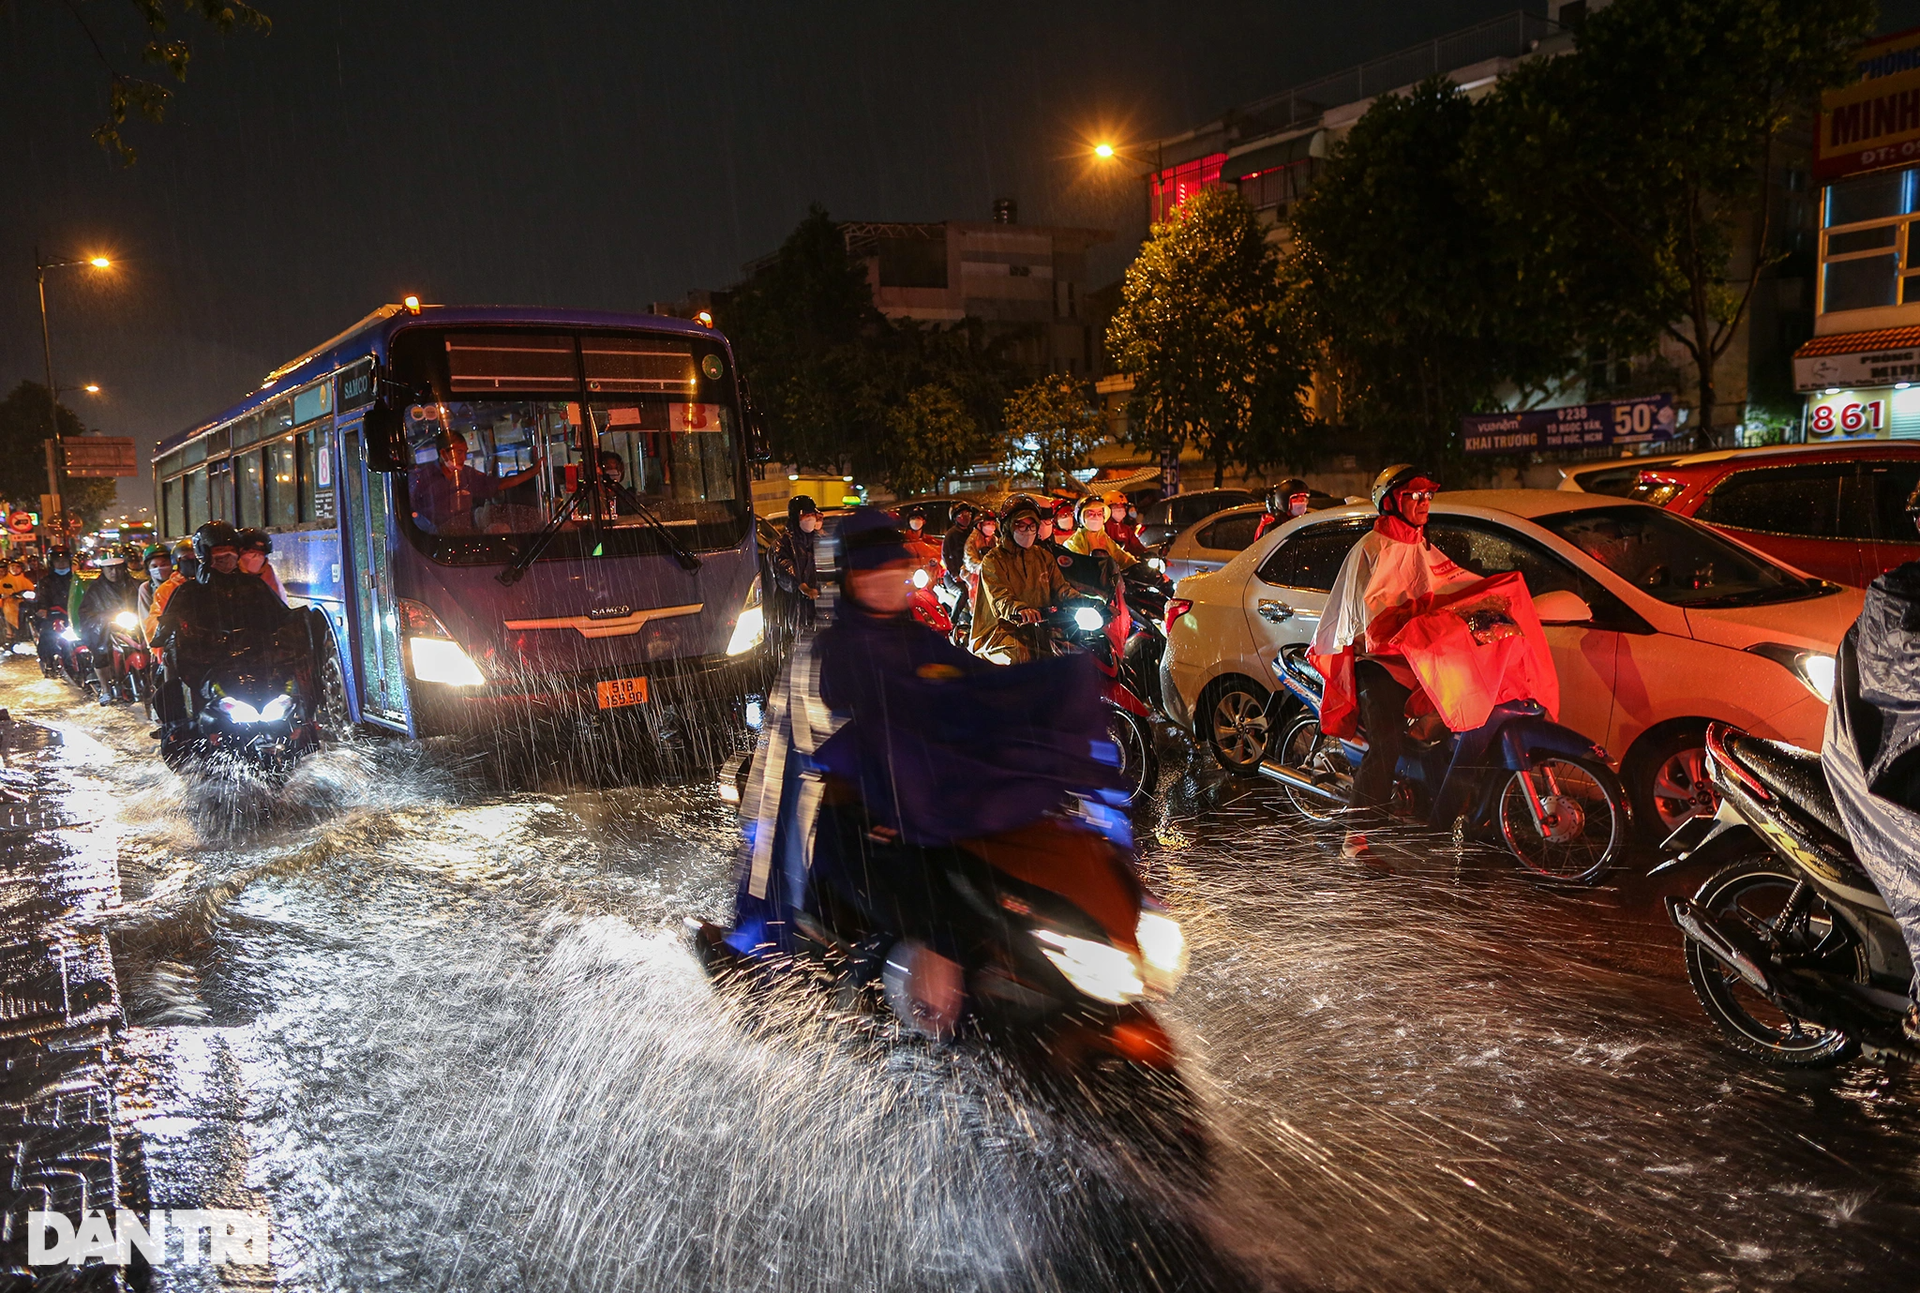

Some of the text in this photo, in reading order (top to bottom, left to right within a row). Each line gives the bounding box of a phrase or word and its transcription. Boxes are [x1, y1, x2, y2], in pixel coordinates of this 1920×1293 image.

[345, 375, 368, 399] SAMCO
[682, 403, 707, 429] 8
[1811, 400, 1884, 433] 861
[320, 450, 328, 483] 8
[591, 605, 630, 616] SAMCO
